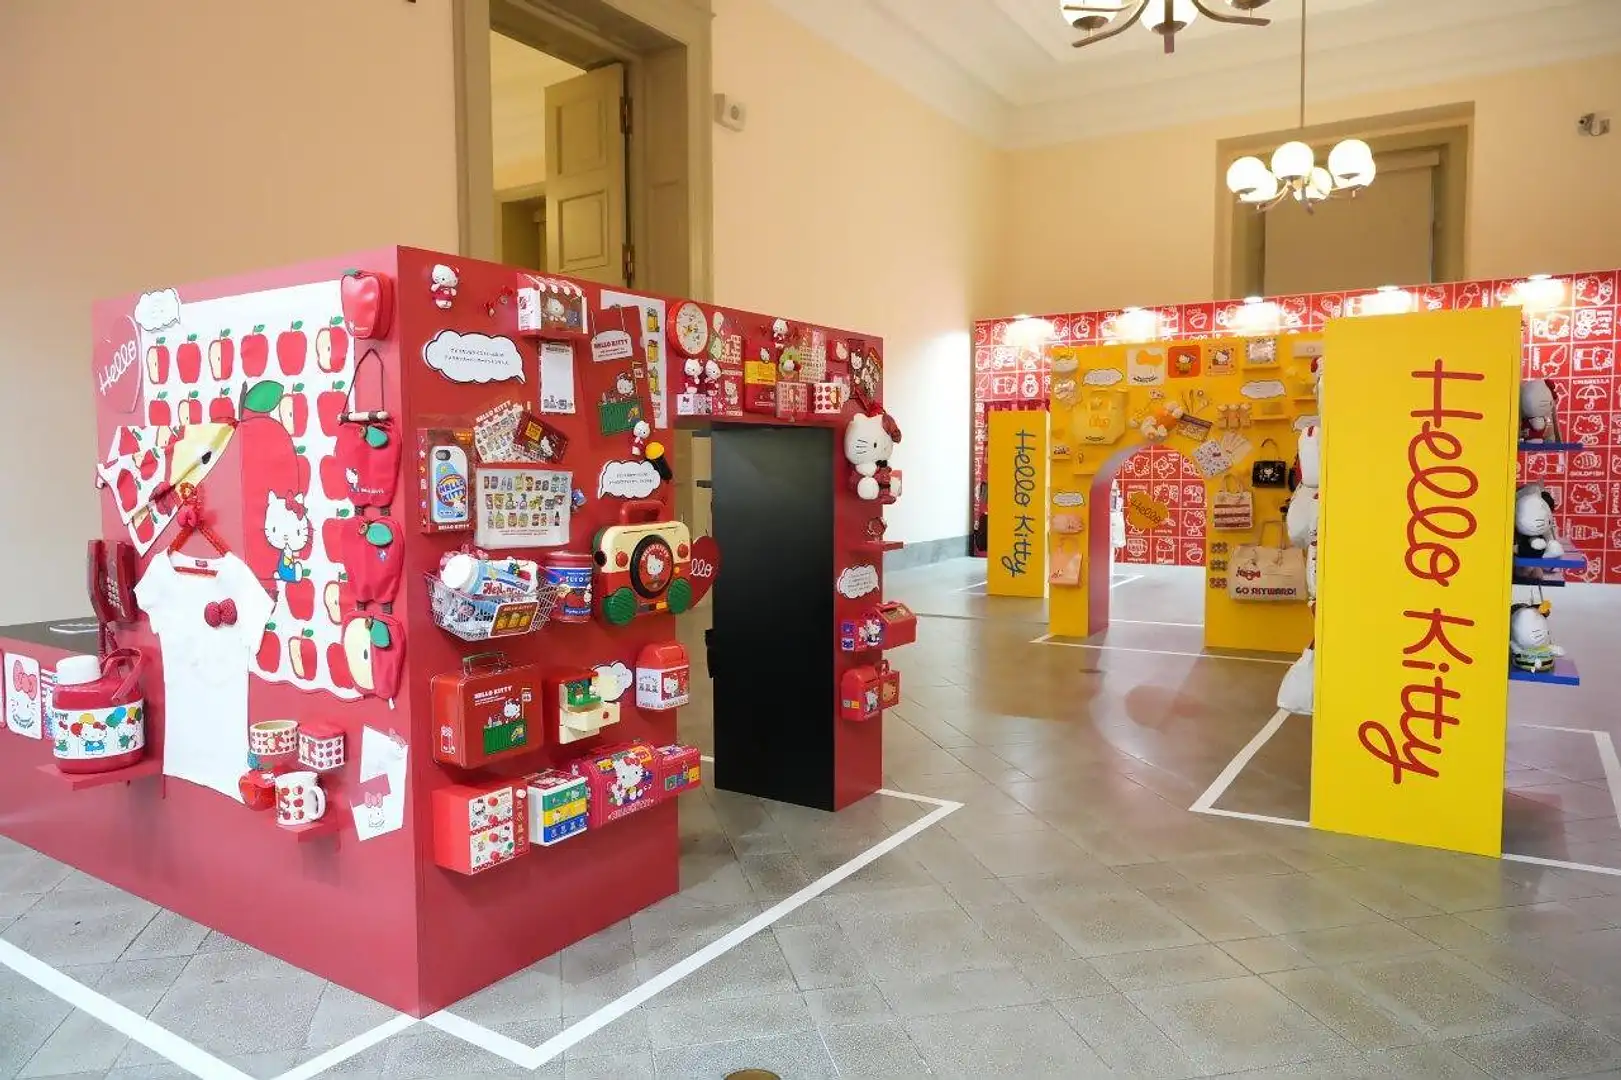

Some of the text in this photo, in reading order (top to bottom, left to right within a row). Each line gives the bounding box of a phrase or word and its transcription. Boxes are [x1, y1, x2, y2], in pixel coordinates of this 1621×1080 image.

[98, 340, 137, 396] Hello
[1001, 429, 1037, 578] Hello Kitty
[690, 558, 714, 578] llo
[1235, 586, 1249, 595] GO
[1358, 358, 1485, 784] Hello Kitty
